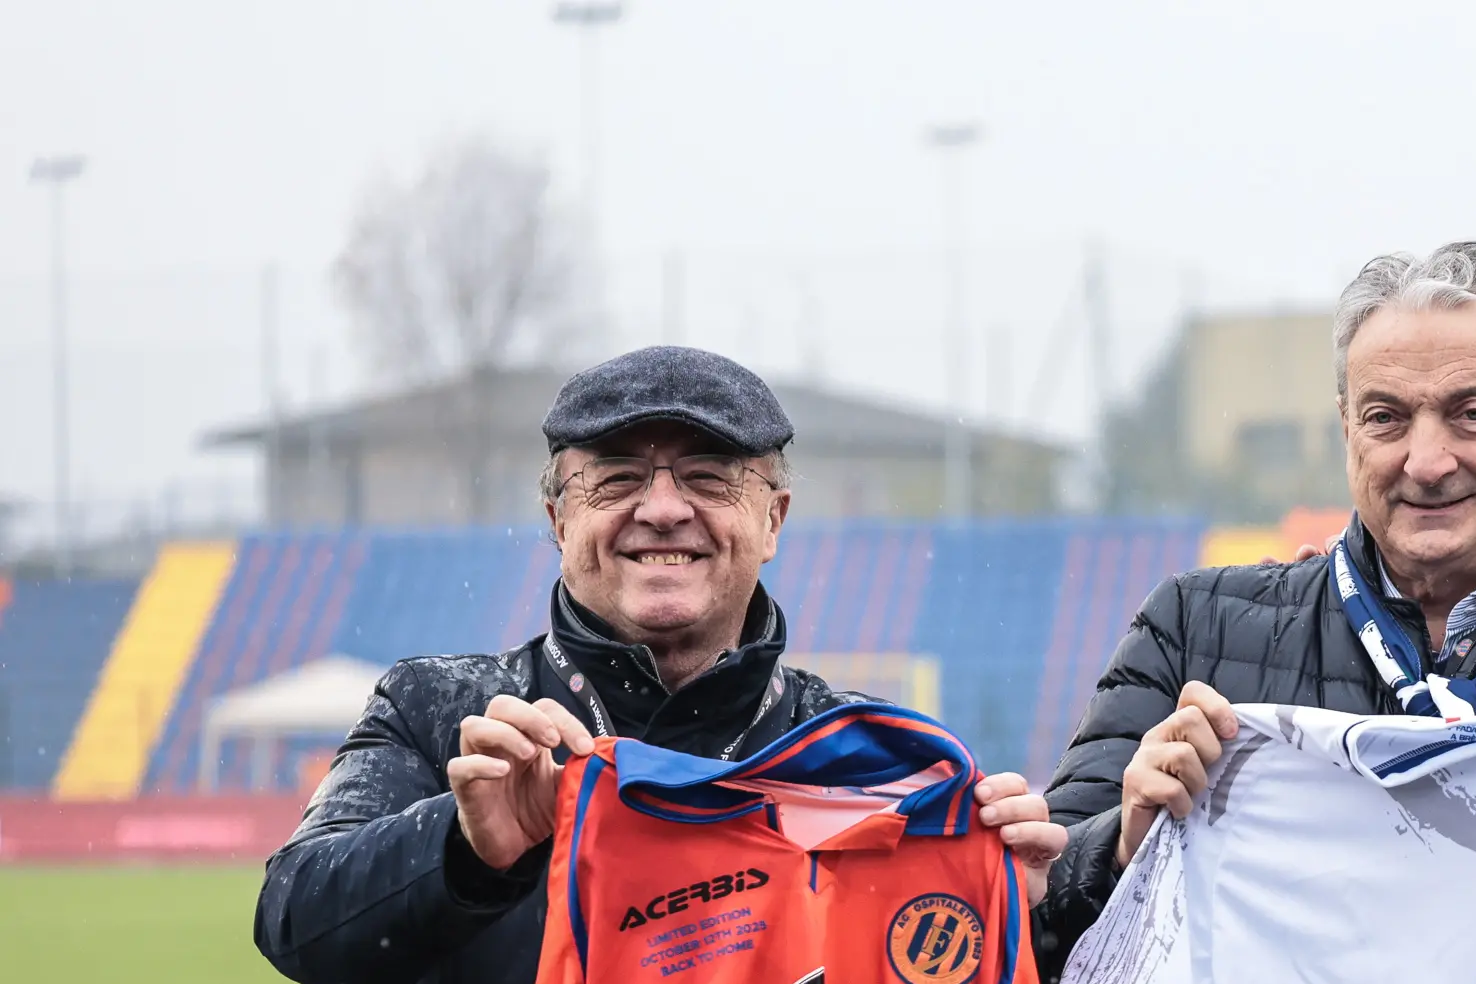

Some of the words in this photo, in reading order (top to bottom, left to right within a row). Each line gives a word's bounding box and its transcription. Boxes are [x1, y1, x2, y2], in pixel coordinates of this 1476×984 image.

[647, 923, 698, 947] LIMITED
[699, 907, 752, 930] EDITION
[913, 898, 981, 932] OSPITALETTO
[640, 939, 700, 967] OCTOBER
[703, 929, 732, 946] 12TH
[661, 958, 696, 977] BACK
[697, 951, 714, 965] TO
[716, 939, 755, 958] HOME
